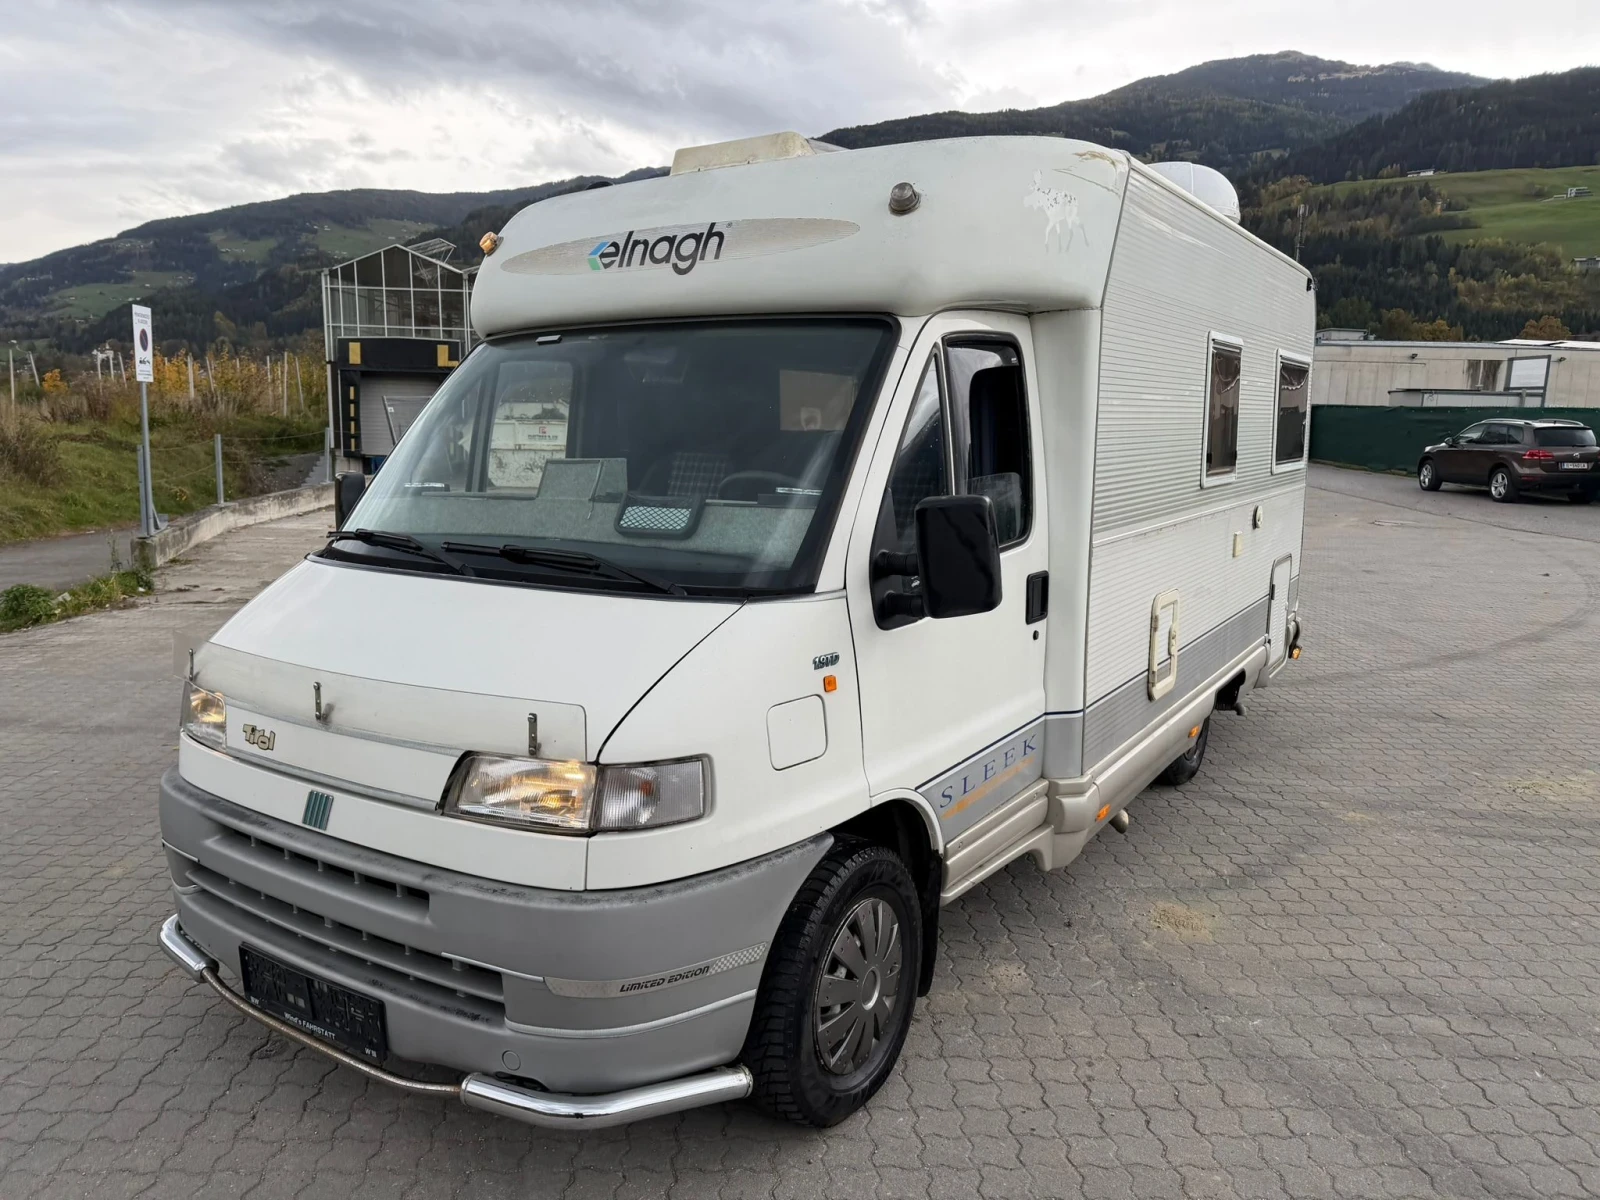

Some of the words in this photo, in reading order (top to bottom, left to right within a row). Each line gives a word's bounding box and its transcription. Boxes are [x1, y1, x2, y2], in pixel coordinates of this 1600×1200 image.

[598, 222, 725, 275] elnagh
[242, 723, 276, 751] Tirol
[940, 733, 1037, 809] SLEEK
